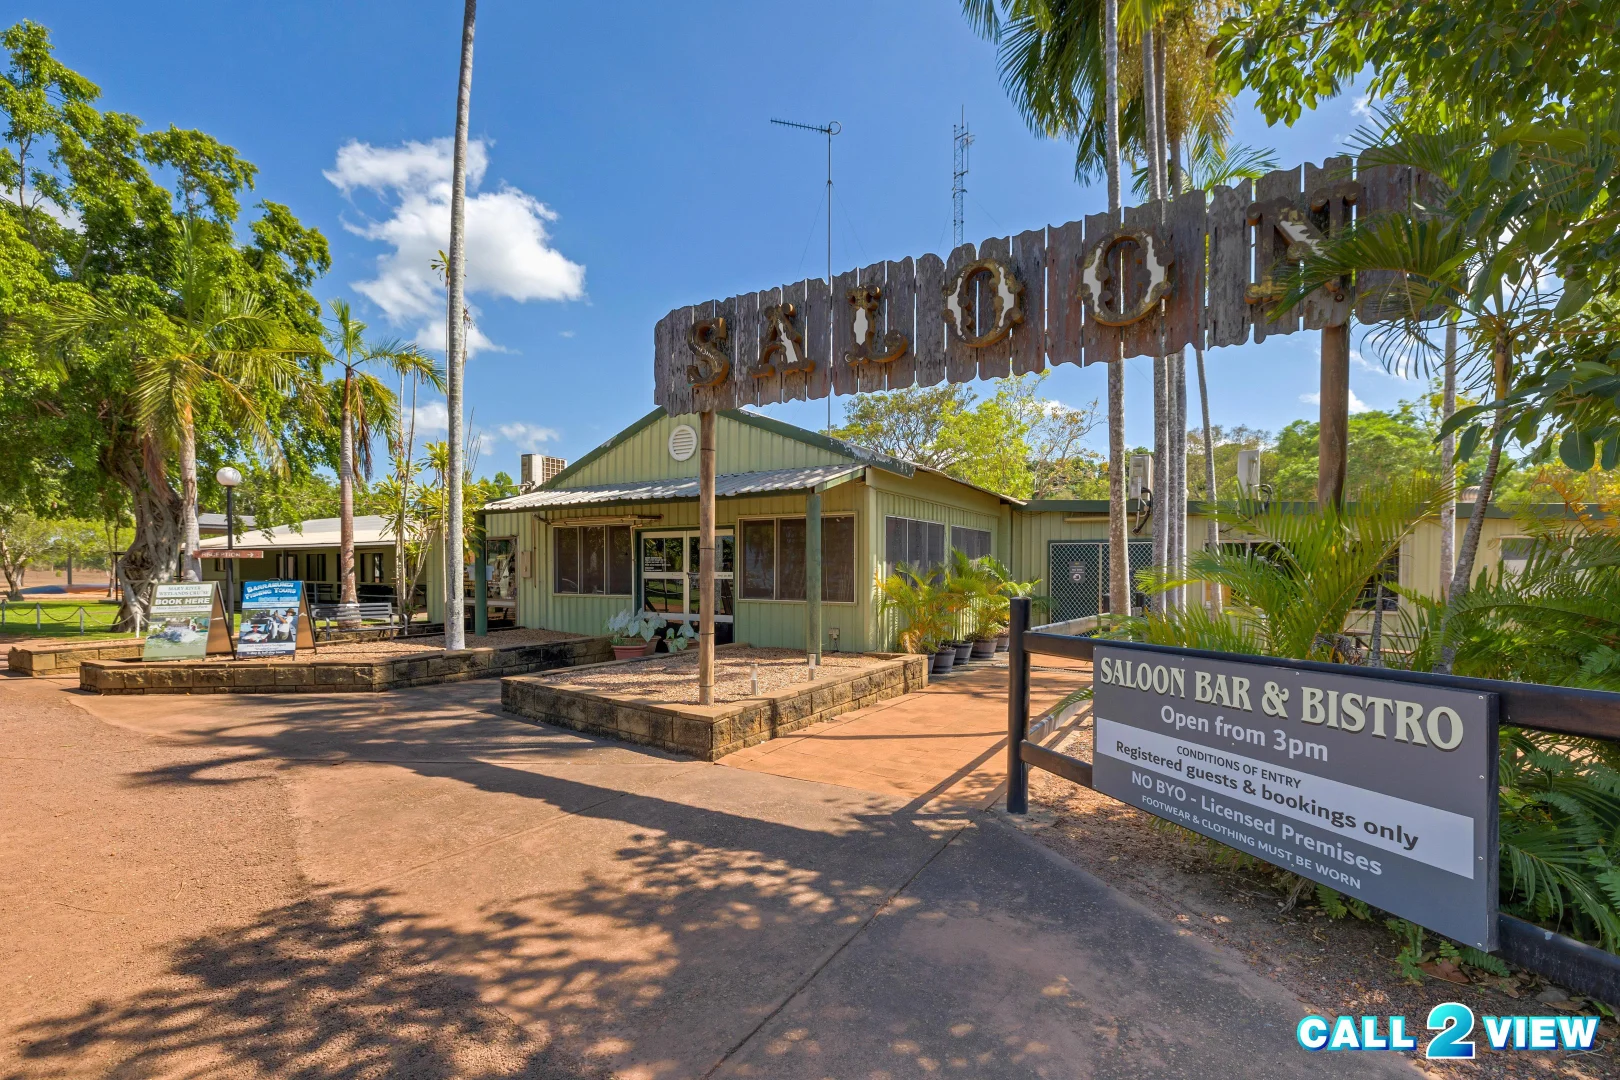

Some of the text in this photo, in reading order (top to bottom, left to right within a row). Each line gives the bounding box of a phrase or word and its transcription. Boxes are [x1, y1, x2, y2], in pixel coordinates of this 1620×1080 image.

[687, 180, 1362, 388] SALOON
[184, 597, 211, 605] HERE
[1100, 656, 1464, 752] SALOON BAR & BISTRO
[1161, 705, 1328, 762] Open from 3pm
[1116, 740, 1419, 851] Registered guests & bookings only
[1176, 745, 1302, 790] CONDITIONS OF ENTRY
[1132, 770, 1153, 789] NO
[1157, 779, 1187, 802] BYO
[1201, 795, 1275, 835] Licensed
[1281, 824, 1383, 876] Premises
[1142, 795, 1361, 890] FOOTWEAR & CLOTHING MUST BE WORN
